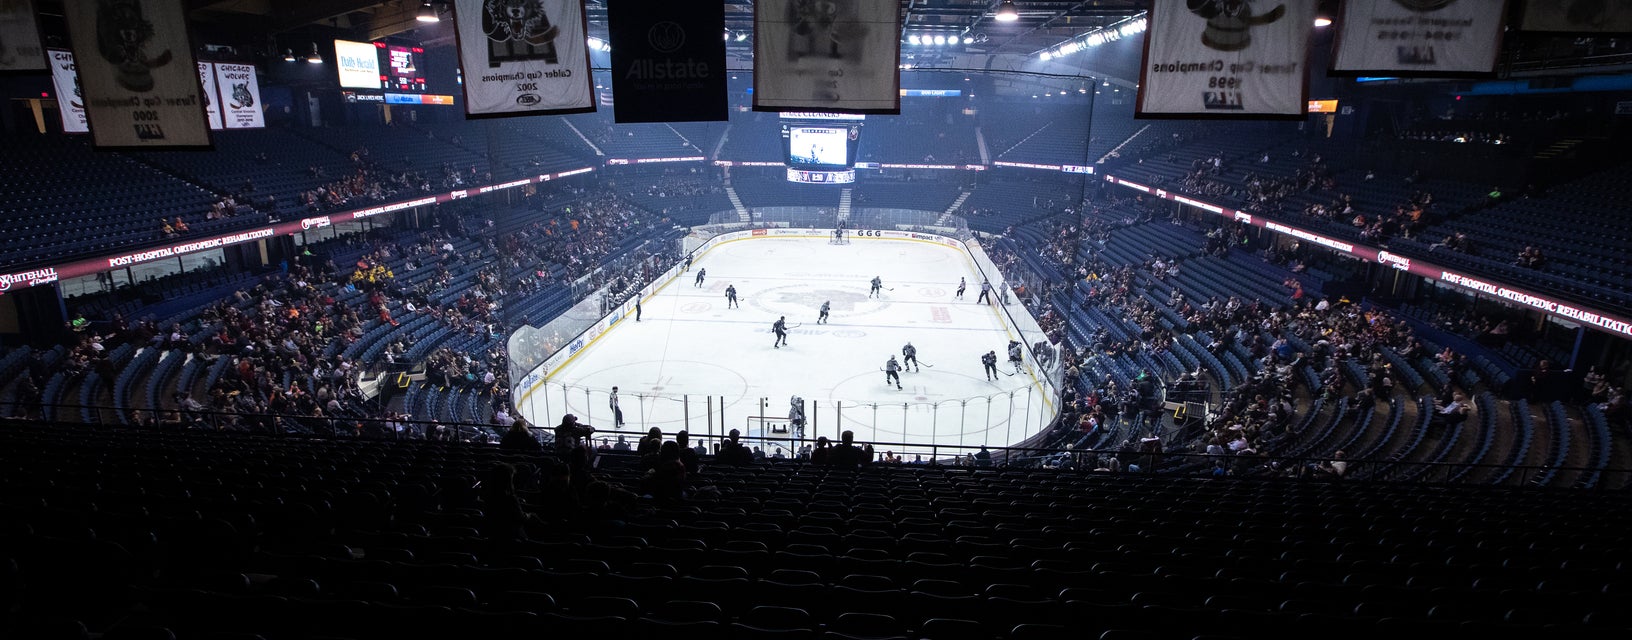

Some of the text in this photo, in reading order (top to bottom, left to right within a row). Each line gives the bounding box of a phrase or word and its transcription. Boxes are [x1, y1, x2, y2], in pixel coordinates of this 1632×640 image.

[220, 65, 251, 73] CHICAGO
[356, 57, 375, 70] Herald
[625, 57, 710, 80] Allstate
[109, 228, 274, 267] POST-HOSPITAL ORTHOPEDIC REHABILITATION
[0, 267, 58, 291] WHITEHALL
[1441, 271, 1497, 295] POST-HOSPITAL
[1497, 287, 1558, 312] ORTHOPEDIC
[569, 338, 584, 355] Hefty
